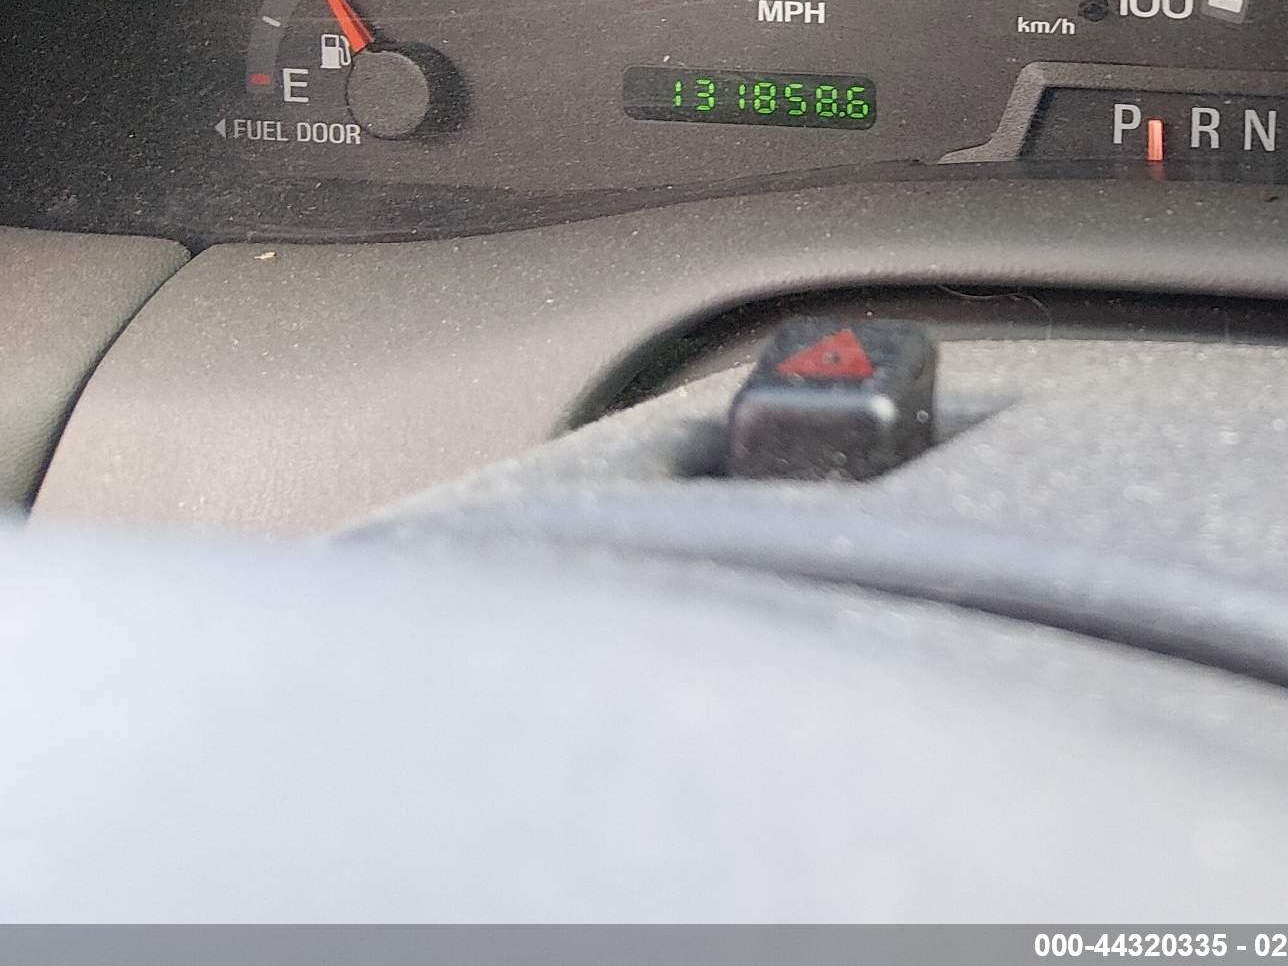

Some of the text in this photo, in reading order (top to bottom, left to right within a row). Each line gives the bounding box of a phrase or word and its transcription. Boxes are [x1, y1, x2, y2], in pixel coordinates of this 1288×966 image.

[758, 0, 825, 23] MPH
[1018, 17, 1075, 34] km/h
[283, 68, 308, 102] E
[673, 79, 870, 119] 131858.6
[233, 120, 360, 144] FUEL DOOR
[1114, 104, 1141, 143] P
[1191, 108, 1219, 148] R
[1244, 110, 1276, 151] N
